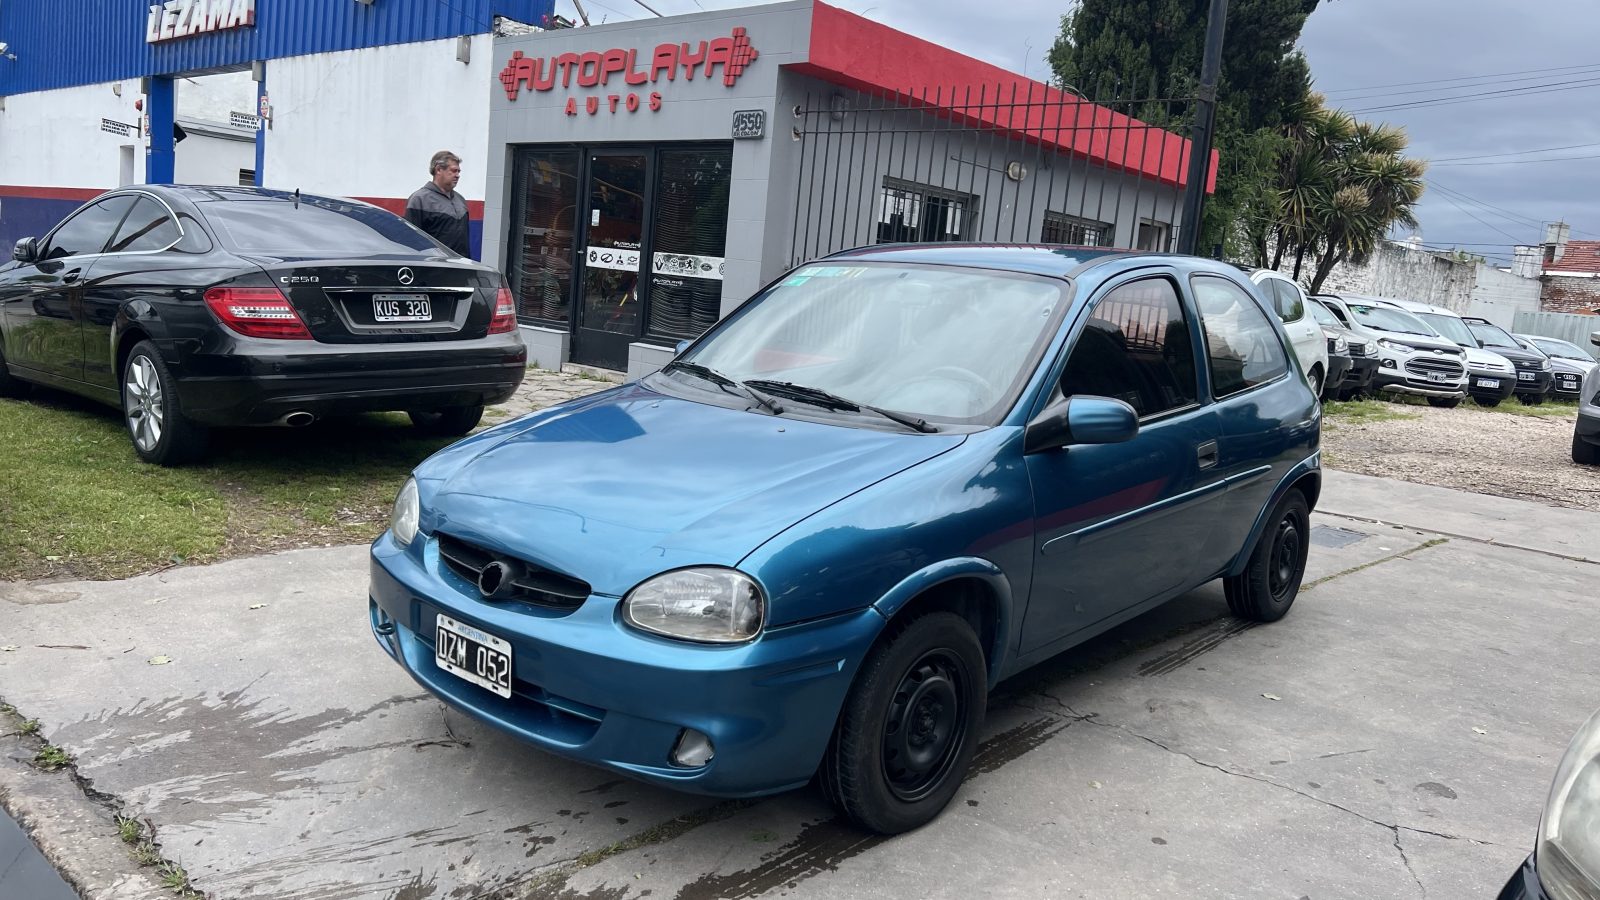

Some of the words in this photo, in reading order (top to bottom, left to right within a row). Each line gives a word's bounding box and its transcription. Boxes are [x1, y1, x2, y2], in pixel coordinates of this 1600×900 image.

[146, 0, 251, 43] LEZAMA
[513, 37, 734, 91] AUTOPLAYA
[564, 92, 662, 116] AUTOS
[734, 113, 761, 131] 4550
[280, 276, 289, 284] C
[376, 301, 400, 316] KUS
[405, 301, 429, 316] 320
[476, 645, 508, 687] 052
